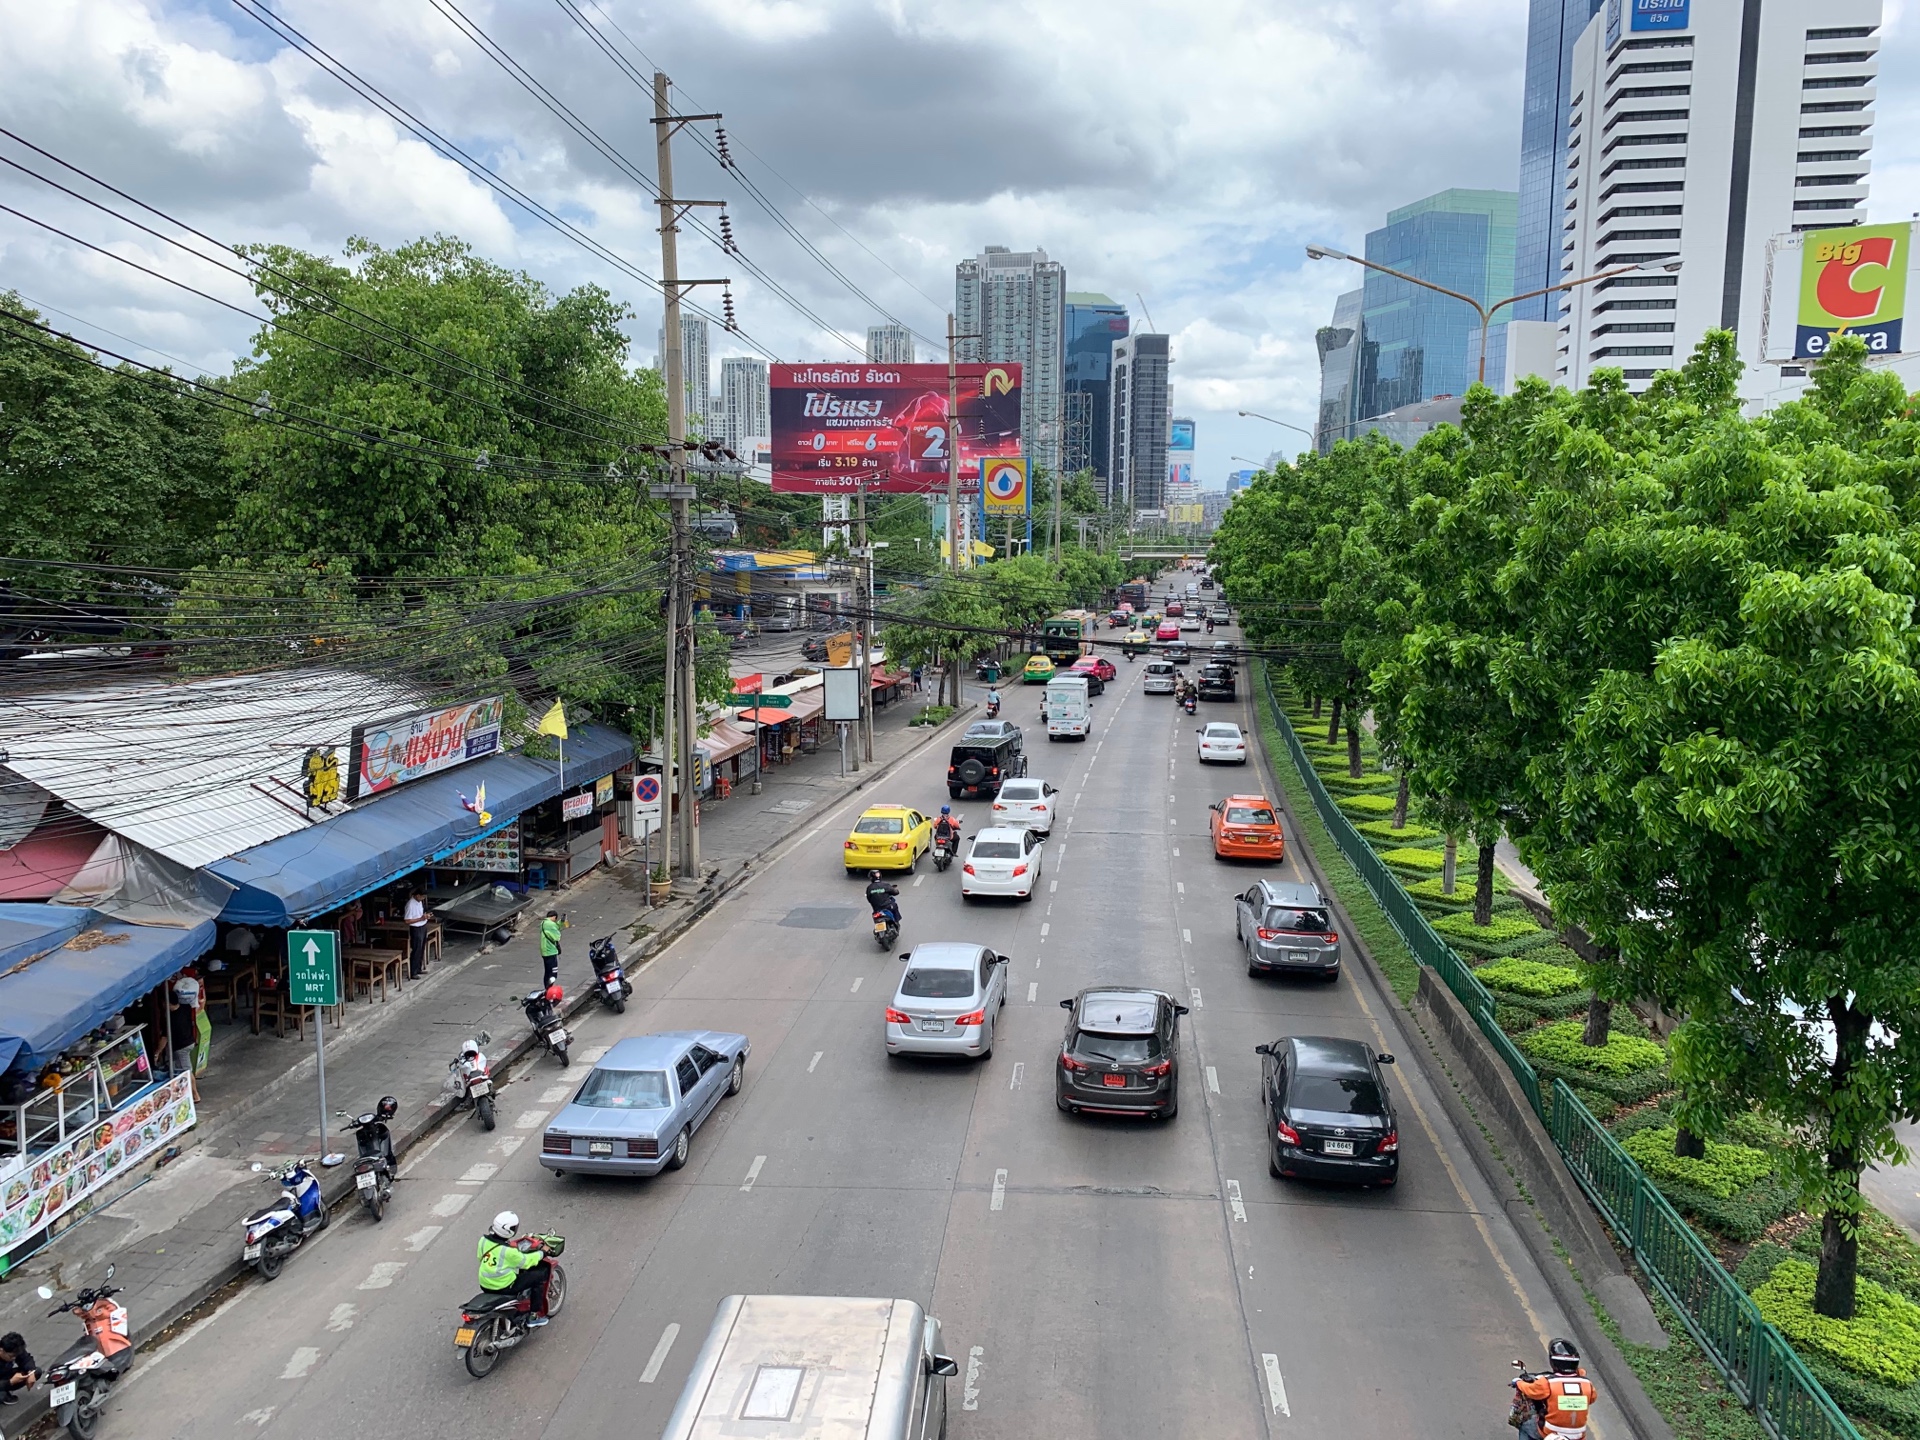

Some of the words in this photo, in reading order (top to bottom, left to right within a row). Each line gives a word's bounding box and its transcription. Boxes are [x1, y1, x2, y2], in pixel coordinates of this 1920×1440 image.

[1816, 241, 1863, 266] Big
[1816, 237, 1897, 319] C
[793, 368, 860, 383] เมโทรลักซ์
[866, 368, 900, 383] รัชดา
[803, 392, 882, 417] โปรแรง
[813, 433, 826, 451] 0
[865, 433, 877, 451] 6
[922, 426, 946, 458] 2
[818, 456, 831, 467] เริ่ม
[835, 456, 858, 467] 3.19
[862, 458, 878, 467] ล้าน
[815, 476, 837, 486] ภายใน
[839, 476, 853, 486] 30
[410, 721, 423, 735] ร้าน
[296, 969, 330, 981] รถไฟฟ้า
[305, 983, 325, 992] MRT
[1336, 1142, 1352, 1150] 6645
